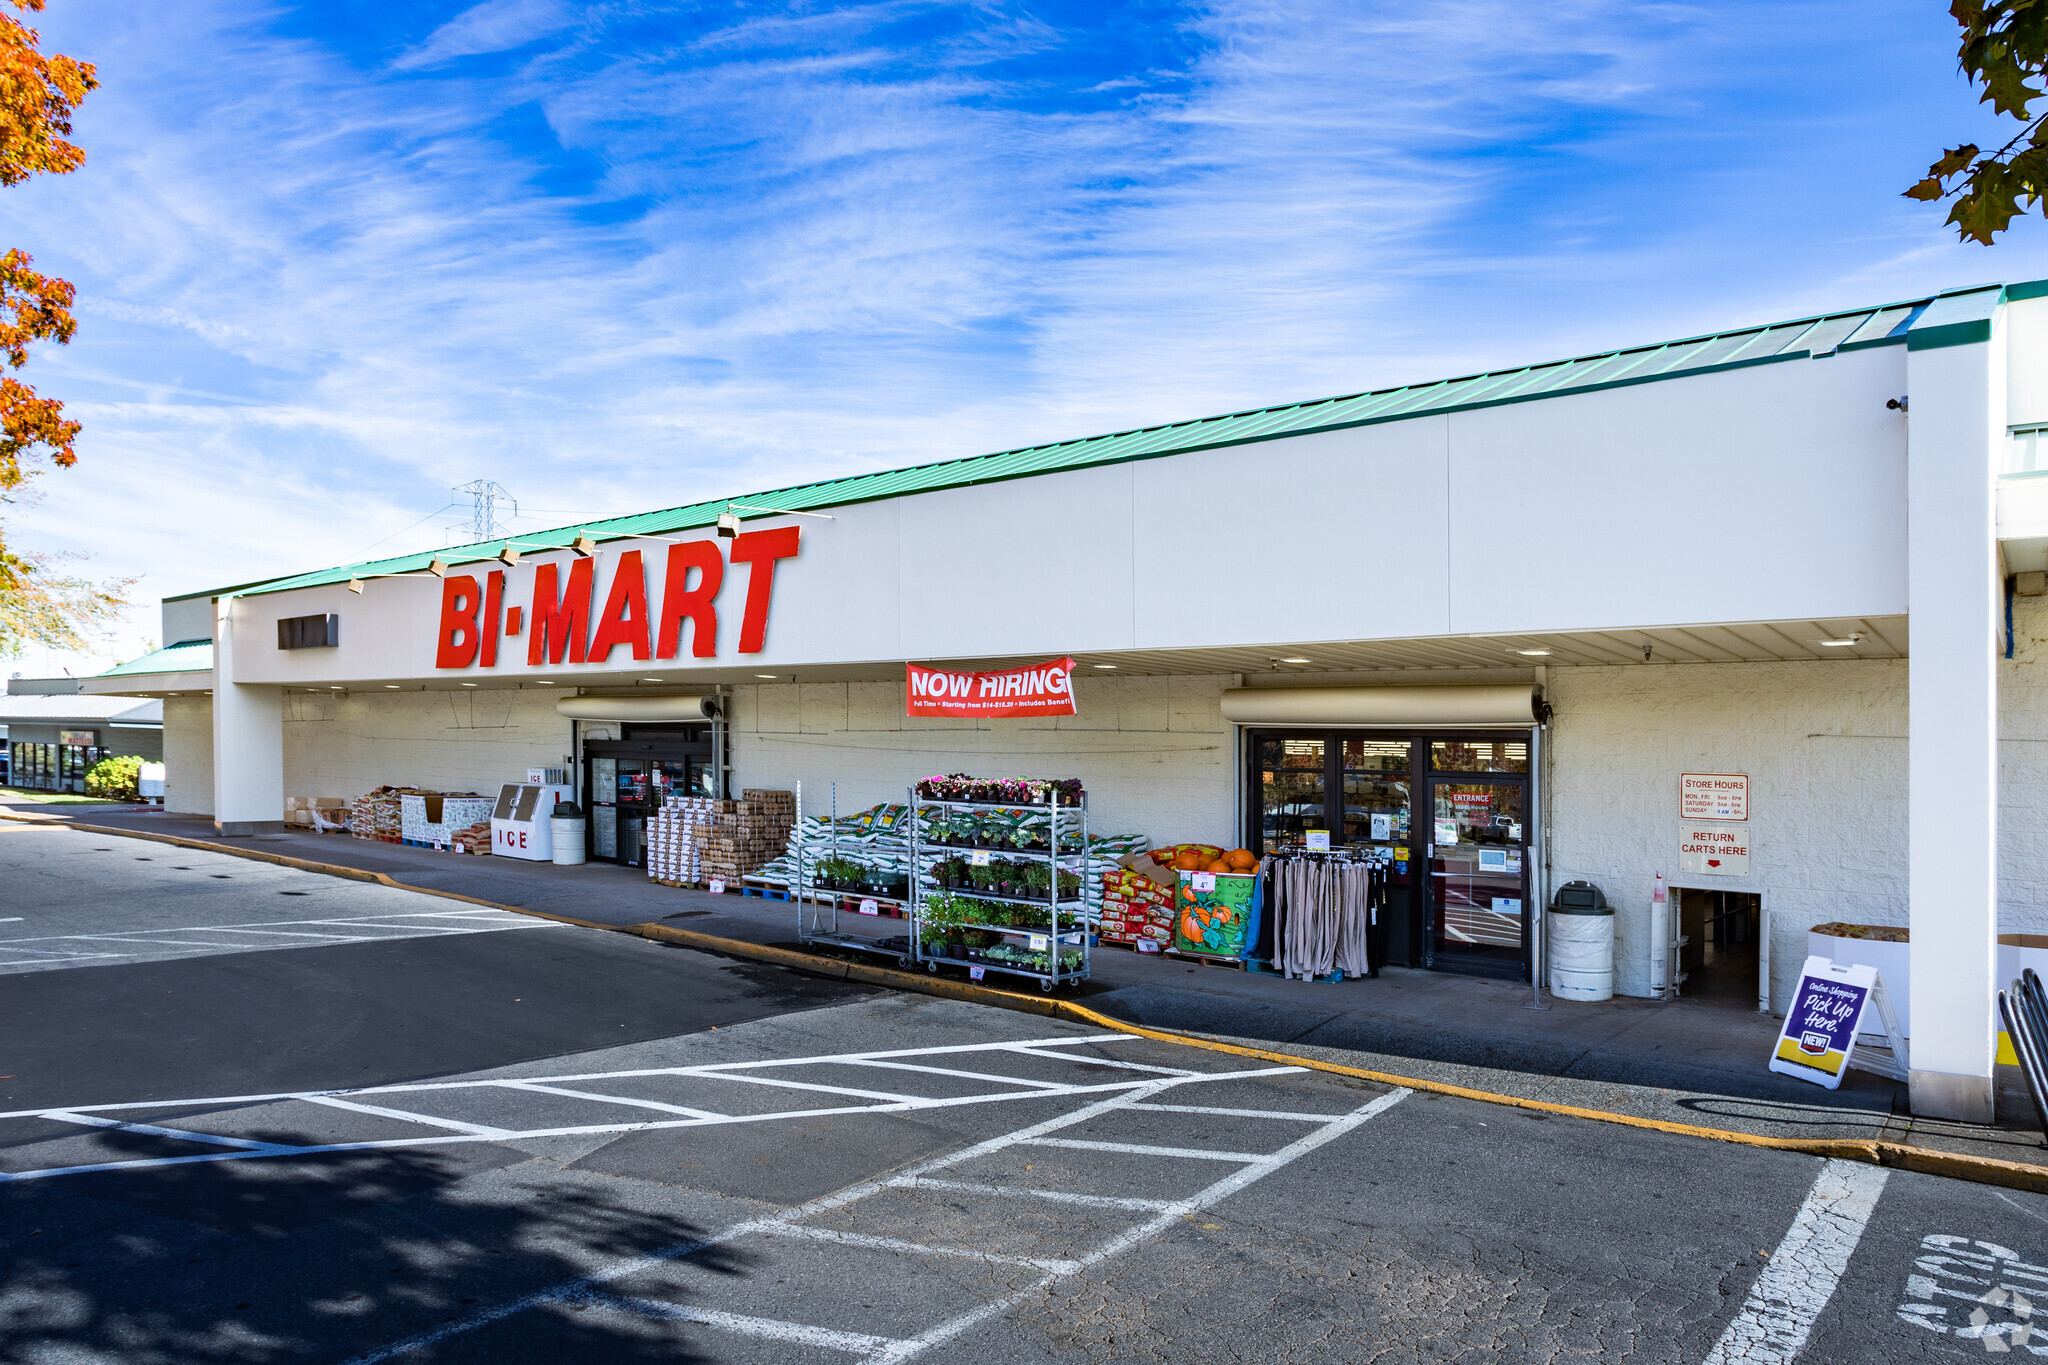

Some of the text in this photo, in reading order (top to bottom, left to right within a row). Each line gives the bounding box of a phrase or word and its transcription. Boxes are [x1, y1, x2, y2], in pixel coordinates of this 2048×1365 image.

[436, 525, 801, 669] BI-MART
[911, 667, 1068, 698] NOW HIRING
[942, 700, 966, 709] Starting
[530, 775, 541, 783] ICE
[1685, 779, 1744, 790] STORE HOURS
[1453, 794, 1490, 803] ENTRANCE
[499, 829, 527, 849] ICE
[1693, 832, 1735, 843] RETURN
[1681, 844, 1747, 856] CARTS HERE
[1809, 982, 1859, 1002] Online Shopping
[1803, 994, 1854, 1023] Pick Up
[1804, 1011, 1838, 1033] Here.
[1803, 1034, 1827, 1048] NEW!
